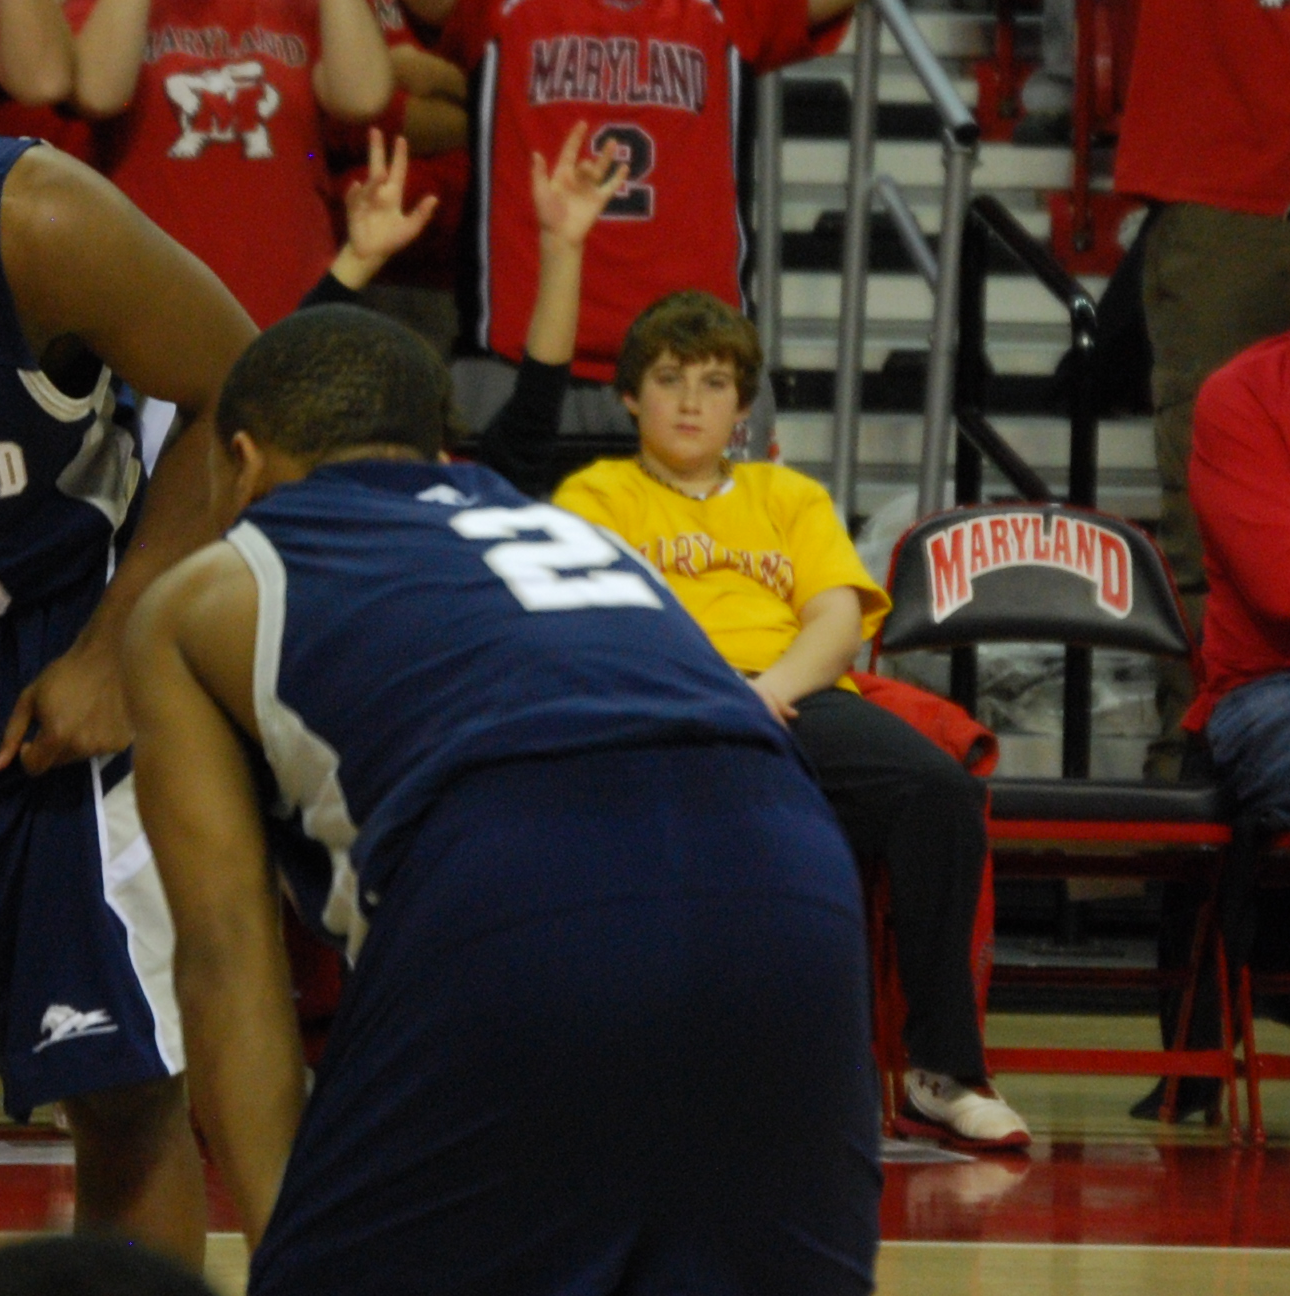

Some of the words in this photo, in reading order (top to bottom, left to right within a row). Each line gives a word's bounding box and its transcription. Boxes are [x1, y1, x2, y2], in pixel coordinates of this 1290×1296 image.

[528, 33, 708, 116] MARYLAND
[590, 120, 656, 223] 2
[448, 504, 665, 612] 2
[925, 513, 1135, 626] MARYLAND
